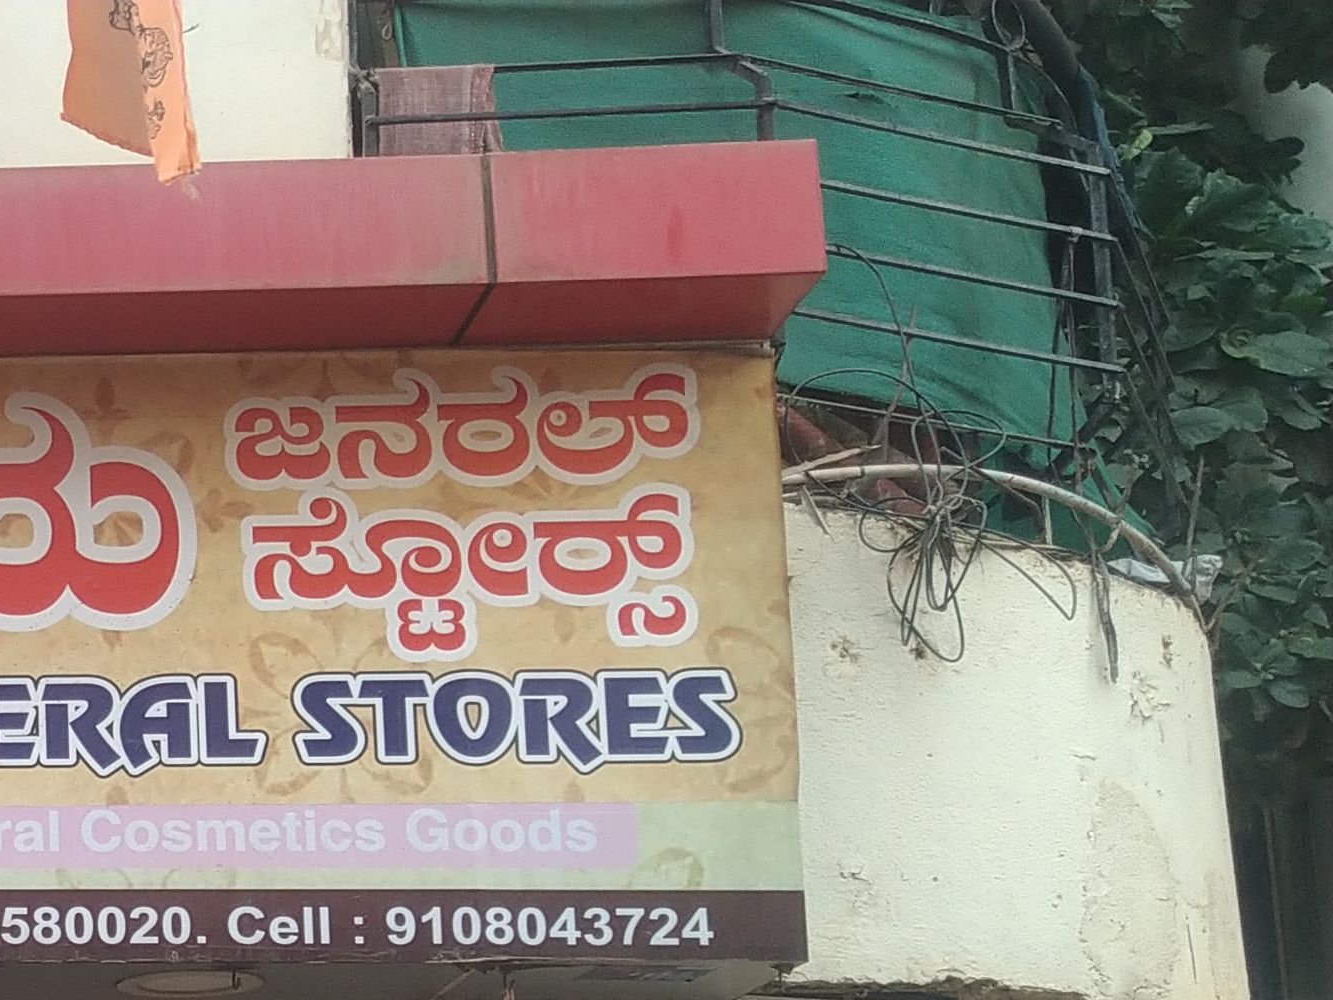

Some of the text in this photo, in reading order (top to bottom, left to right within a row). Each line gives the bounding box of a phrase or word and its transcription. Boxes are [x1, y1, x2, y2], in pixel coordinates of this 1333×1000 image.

[226, 364, 700, 490] ಜನರಲ್
[293, 668, 743, 774] STORES
[81, 808, 385, 854] Cosmetics
[405, 807, 598, 853] Goods
[228, 906, 331, 945] Cell
[386, 906, 714, 946] 9108043724
